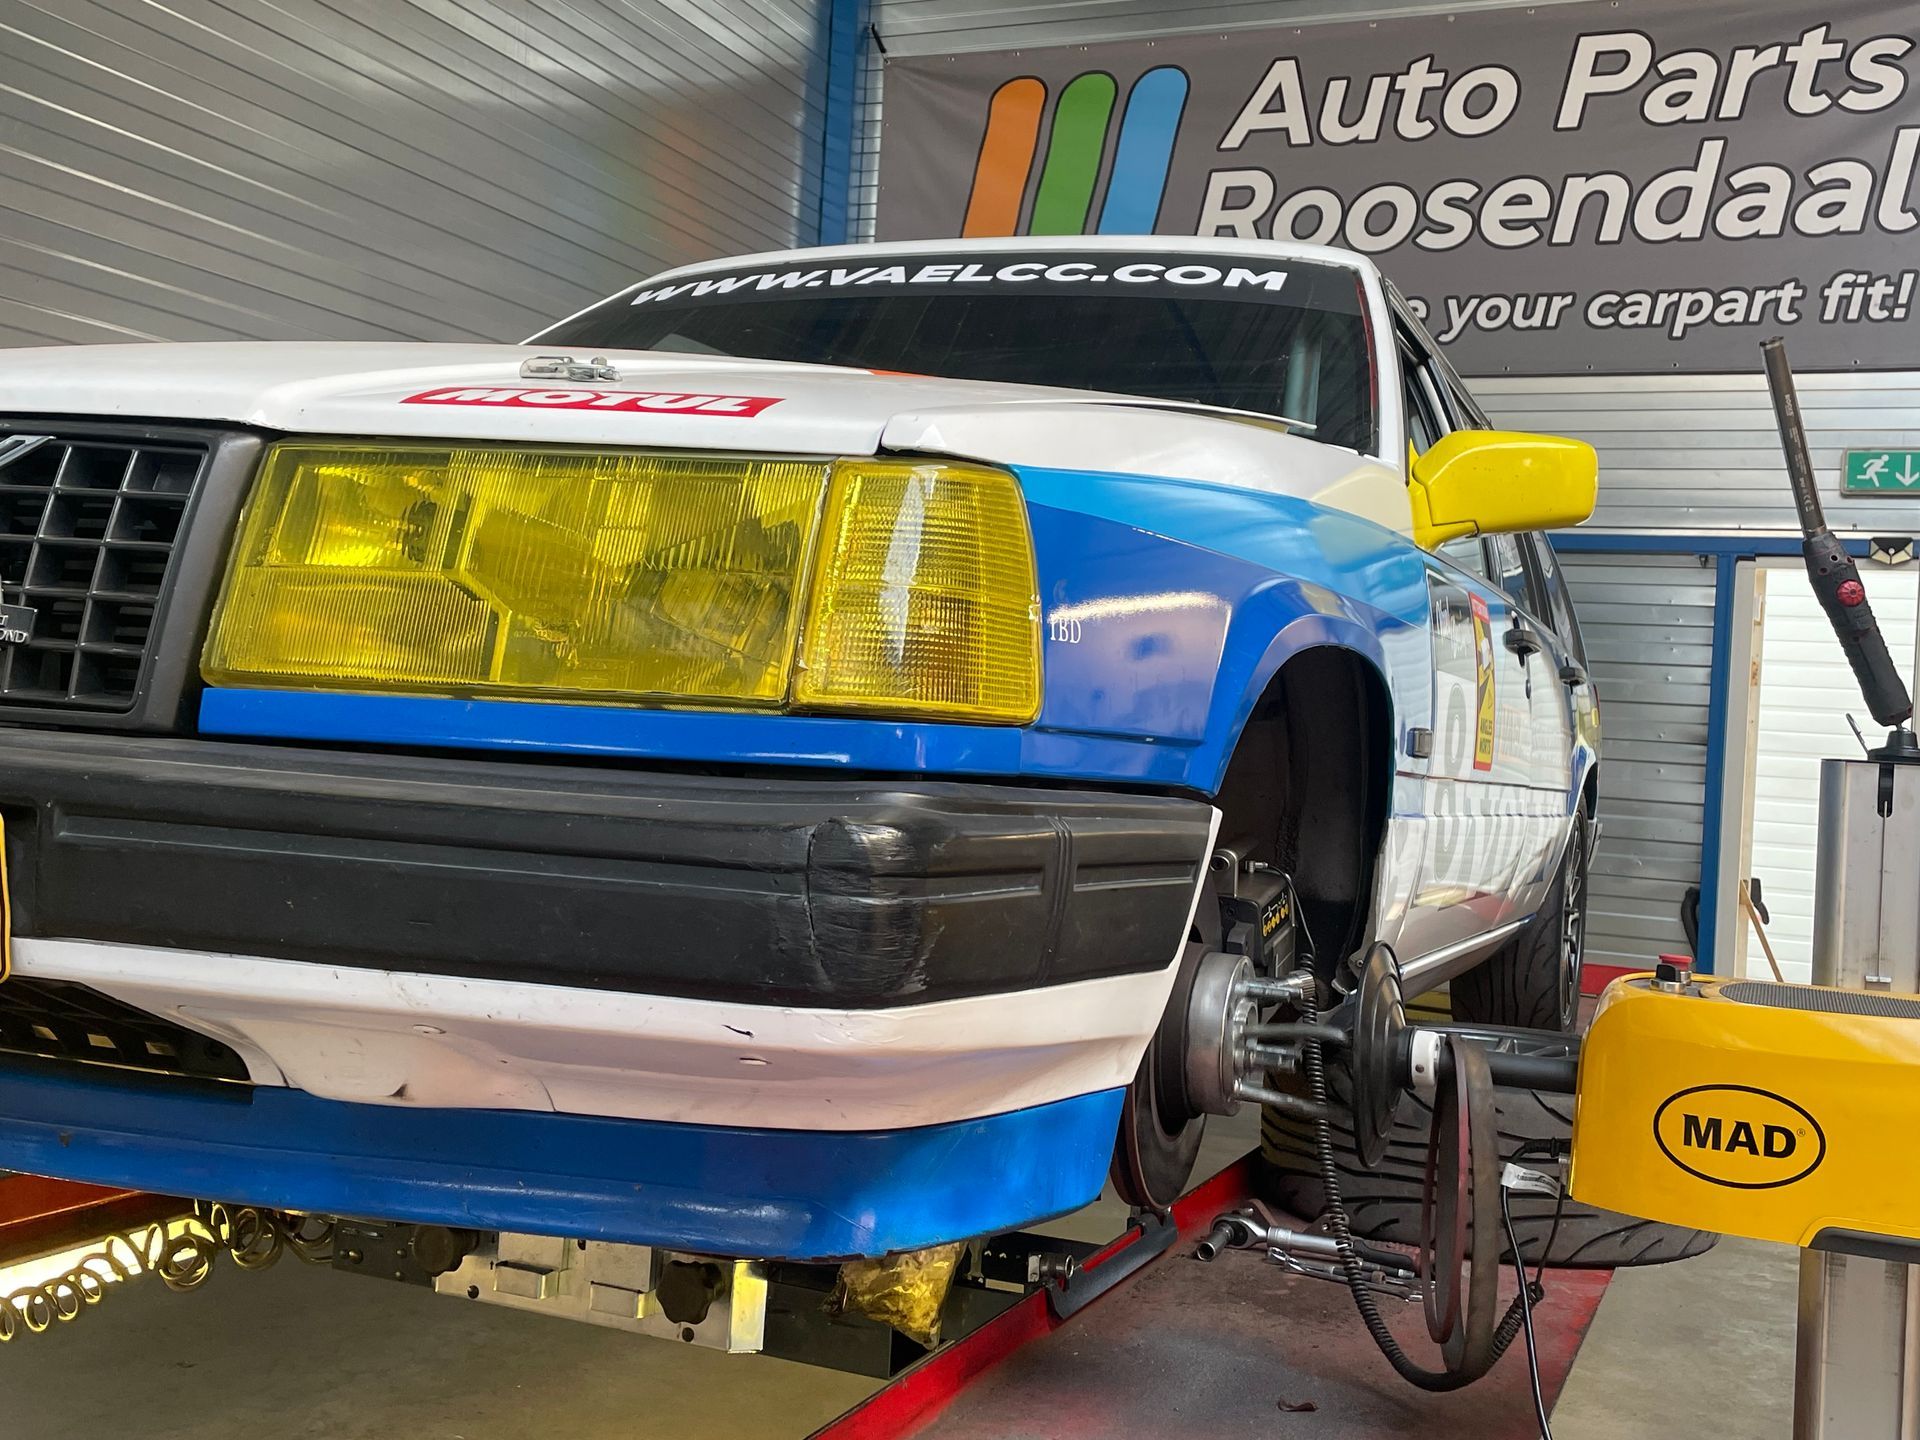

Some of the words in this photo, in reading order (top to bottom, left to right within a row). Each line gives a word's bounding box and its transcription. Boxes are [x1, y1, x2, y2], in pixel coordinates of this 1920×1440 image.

[1218, 56, 1520, 151] Auto
[1554, 24, 1913, 131] Parts
[1198, 131, 1919, 250] Roosendaal
[631, 263, 1286, 306] WWW.VAELCC.COM
[1437, 295, 1571, 342] your
[1587, 281, 1801, 338] carpart
[1824, 273, 1915, 320] fit!
[419, 388, 754, 413] MOTUL
[1682, 1113, 1797, 1159] MAD
